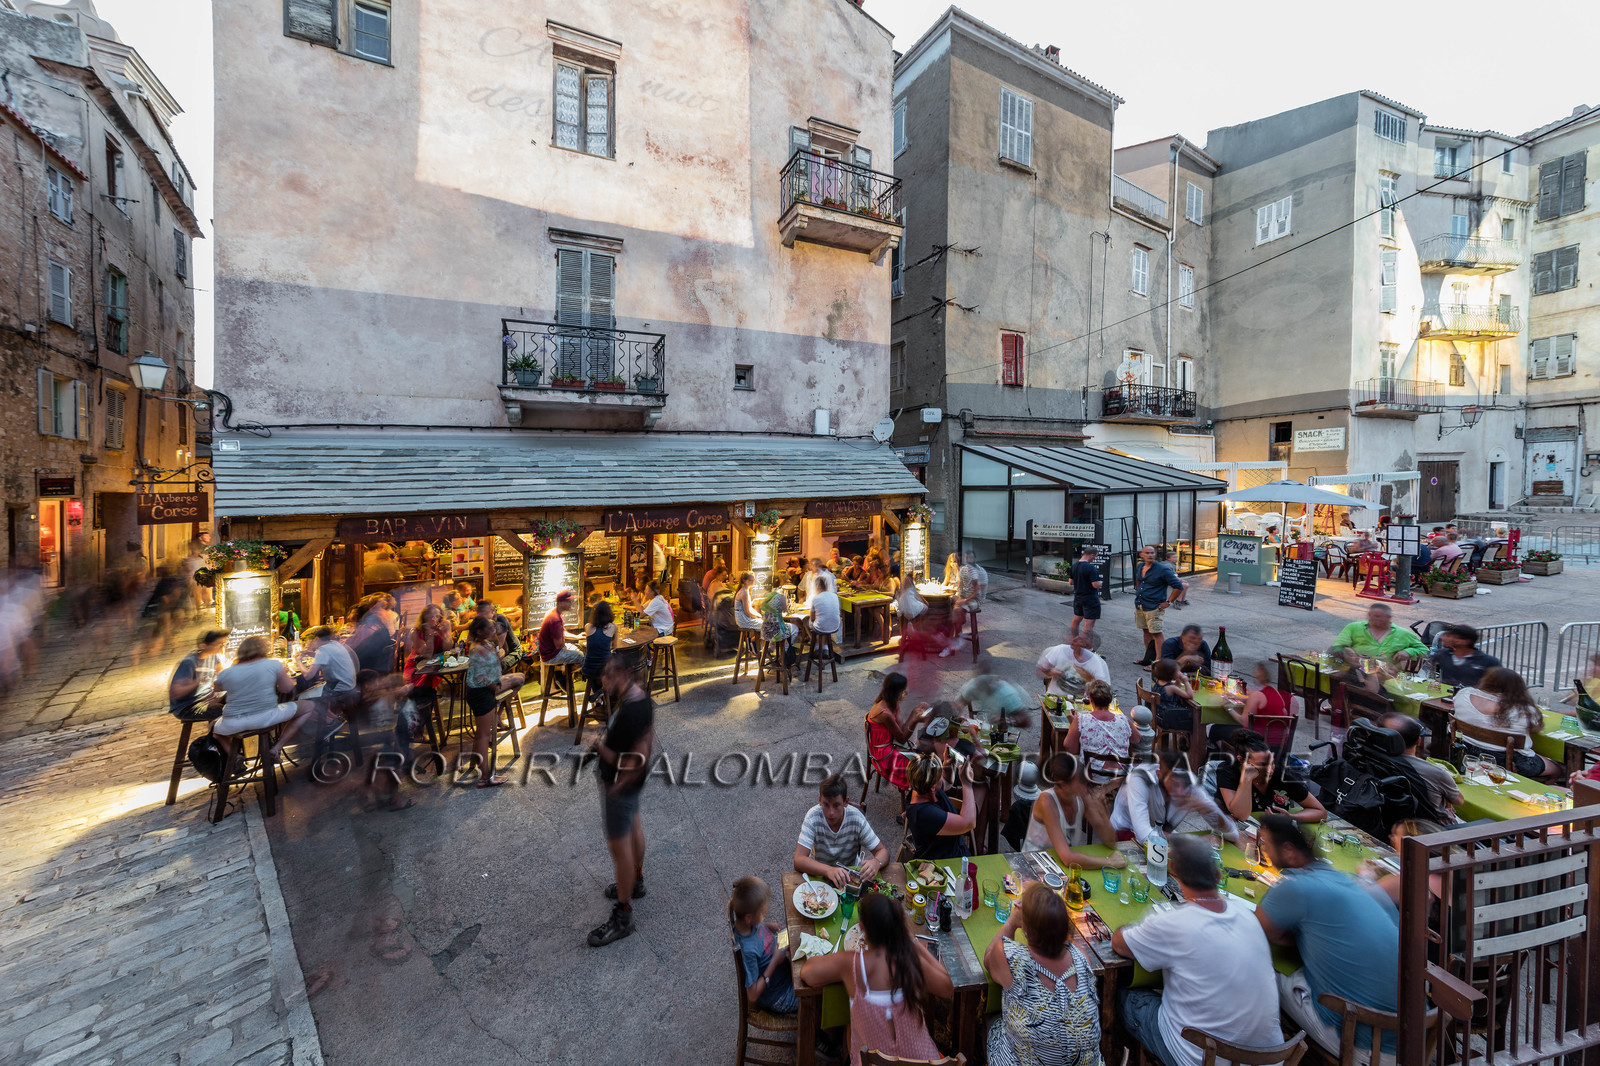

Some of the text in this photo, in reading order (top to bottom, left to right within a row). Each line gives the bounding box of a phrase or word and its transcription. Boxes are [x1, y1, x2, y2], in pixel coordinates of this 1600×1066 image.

[1297, 430, 1323, 438] SNACK
[139, 493, 198, 506] L'Auberge
[151, 505, 198, 519] Corse
[365, 519, 407, 535] BAR
[430, 516, 468, 532] VIN
[608, 509, 722, 532] L'Auberge Corse
[1223, 554, 1256, 564] Emporter
